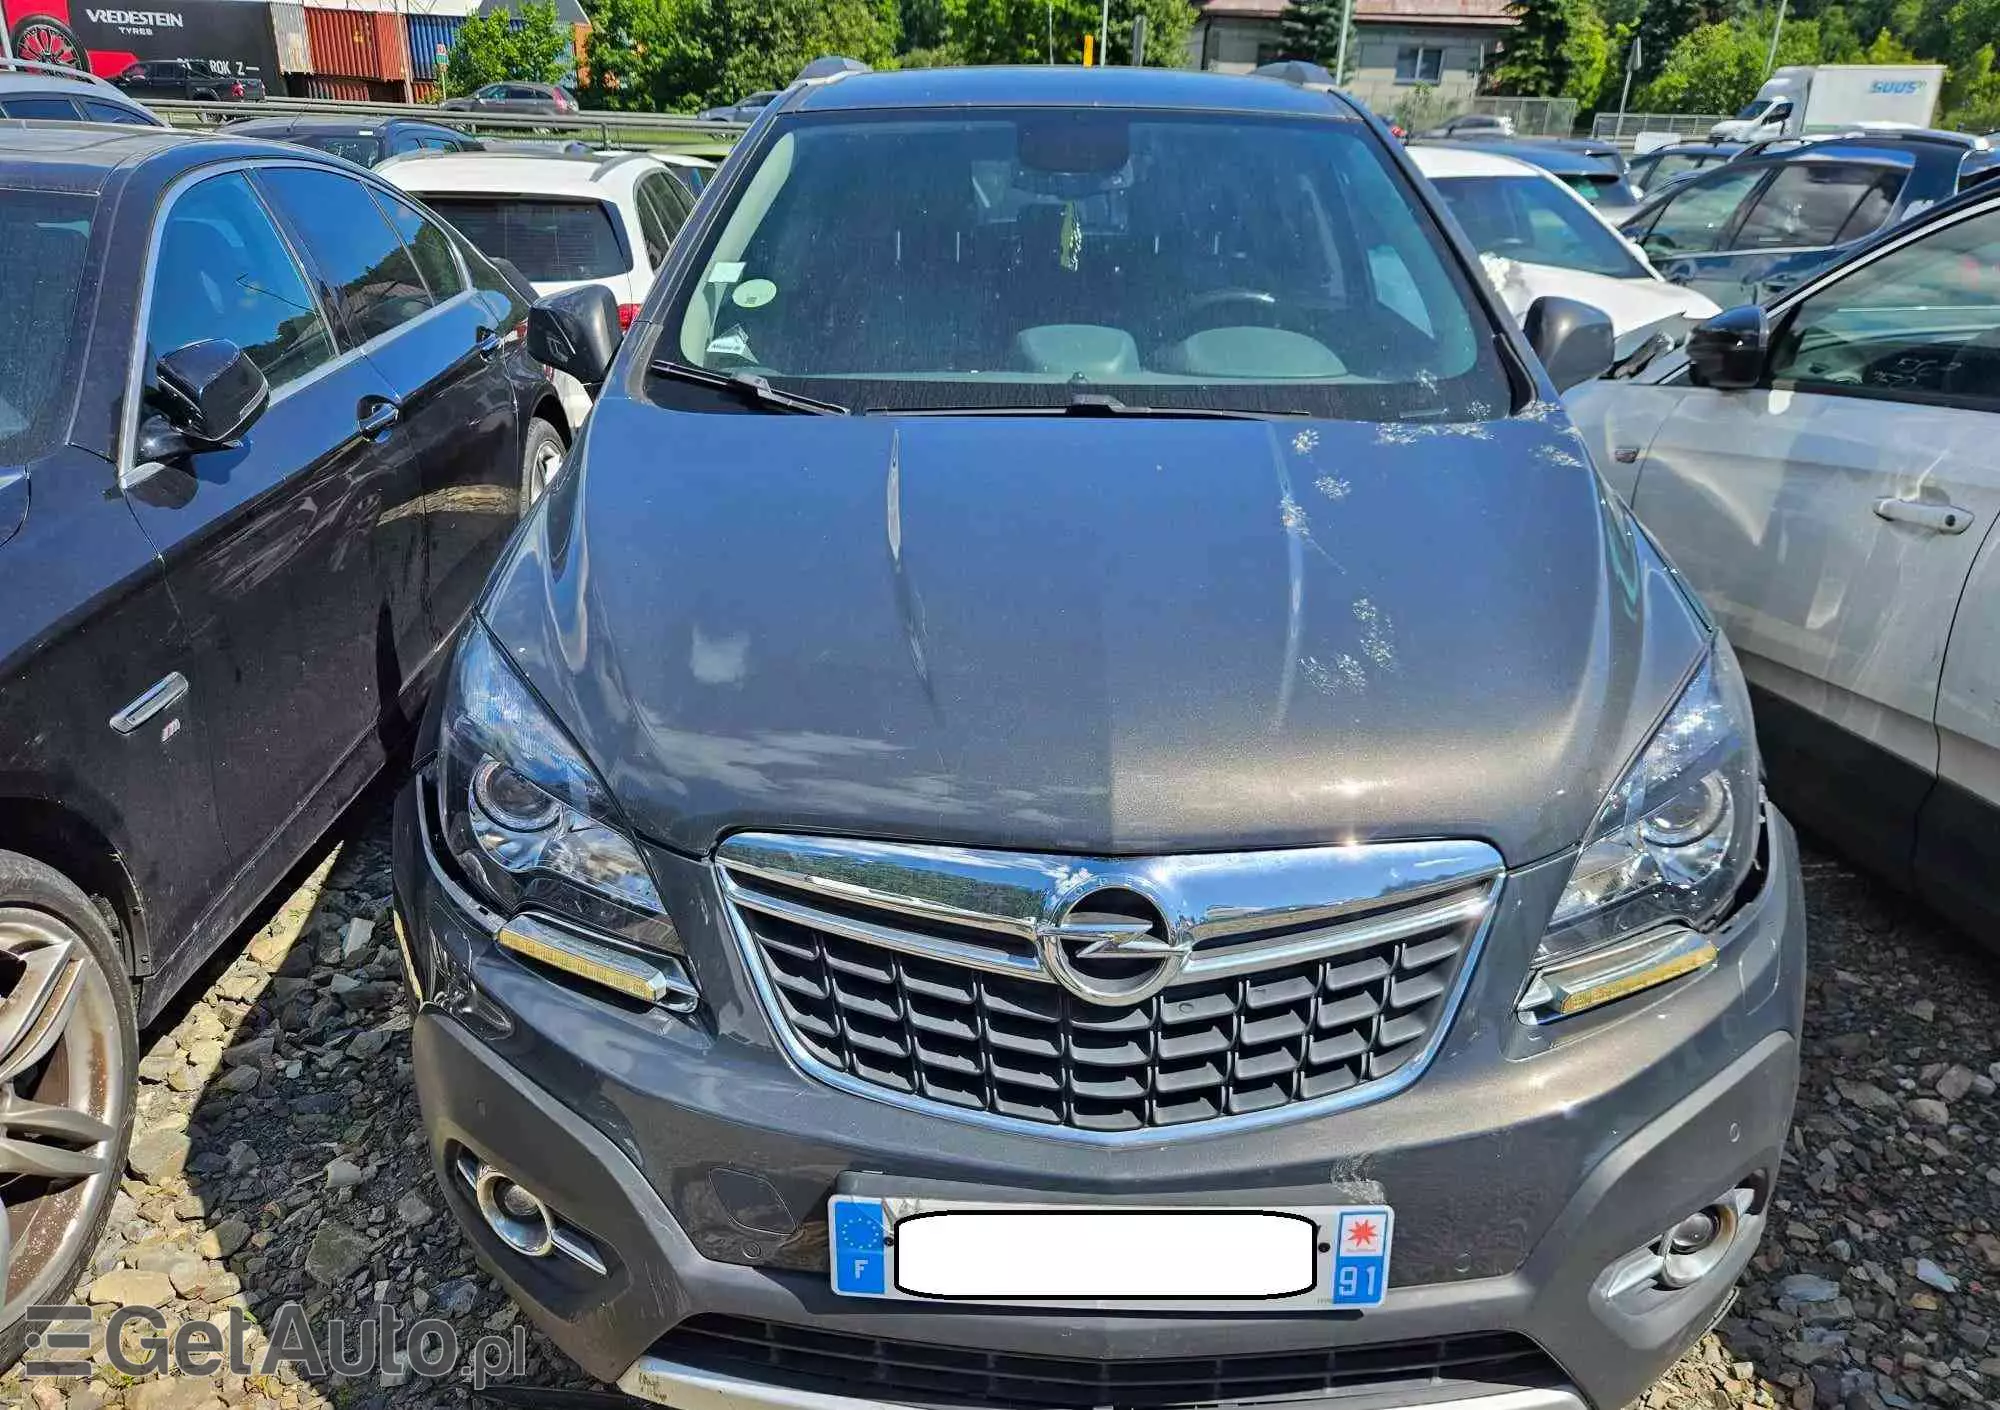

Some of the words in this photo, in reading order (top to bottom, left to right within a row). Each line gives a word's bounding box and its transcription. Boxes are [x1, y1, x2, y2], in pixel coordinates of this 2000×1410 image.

[86, 8, 183, 27] VREDESTEIN
[118, 26, 153, 36] TYRES
[855, 1259, 869, 1279] F
[1338, 1266, 1377, 1296] 91
